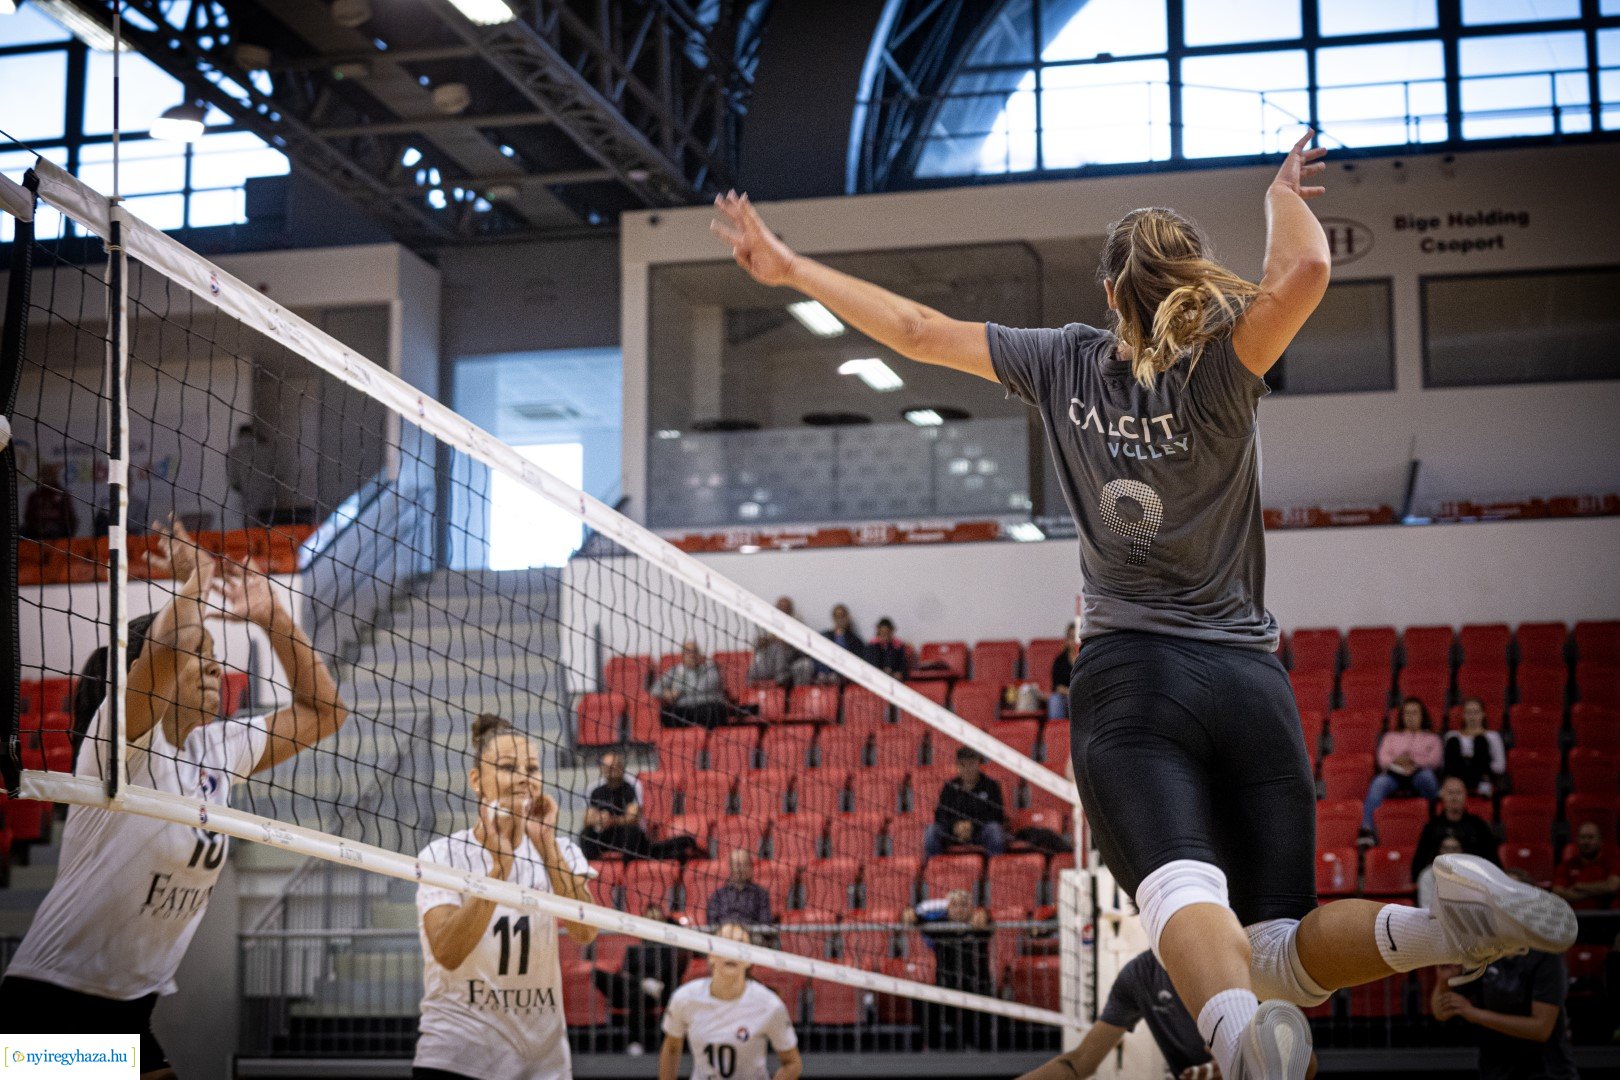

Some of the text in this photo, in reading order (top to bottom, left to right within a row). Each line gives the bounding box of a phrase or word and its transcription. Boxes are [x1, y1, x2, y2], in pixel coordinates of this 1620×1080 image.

[1394, 209, 1530, 233] Bige Holding
[1421, 235, 1504, 254] Csoport
[1068, 397, 1174, 443] CALCIT
[1107, 436, 1190, 461] VOLLEY
[1099, 478, 1164, 566] 9
[493, 915, 530, 976] 11
[703, 1043, 737, 1078] 10
